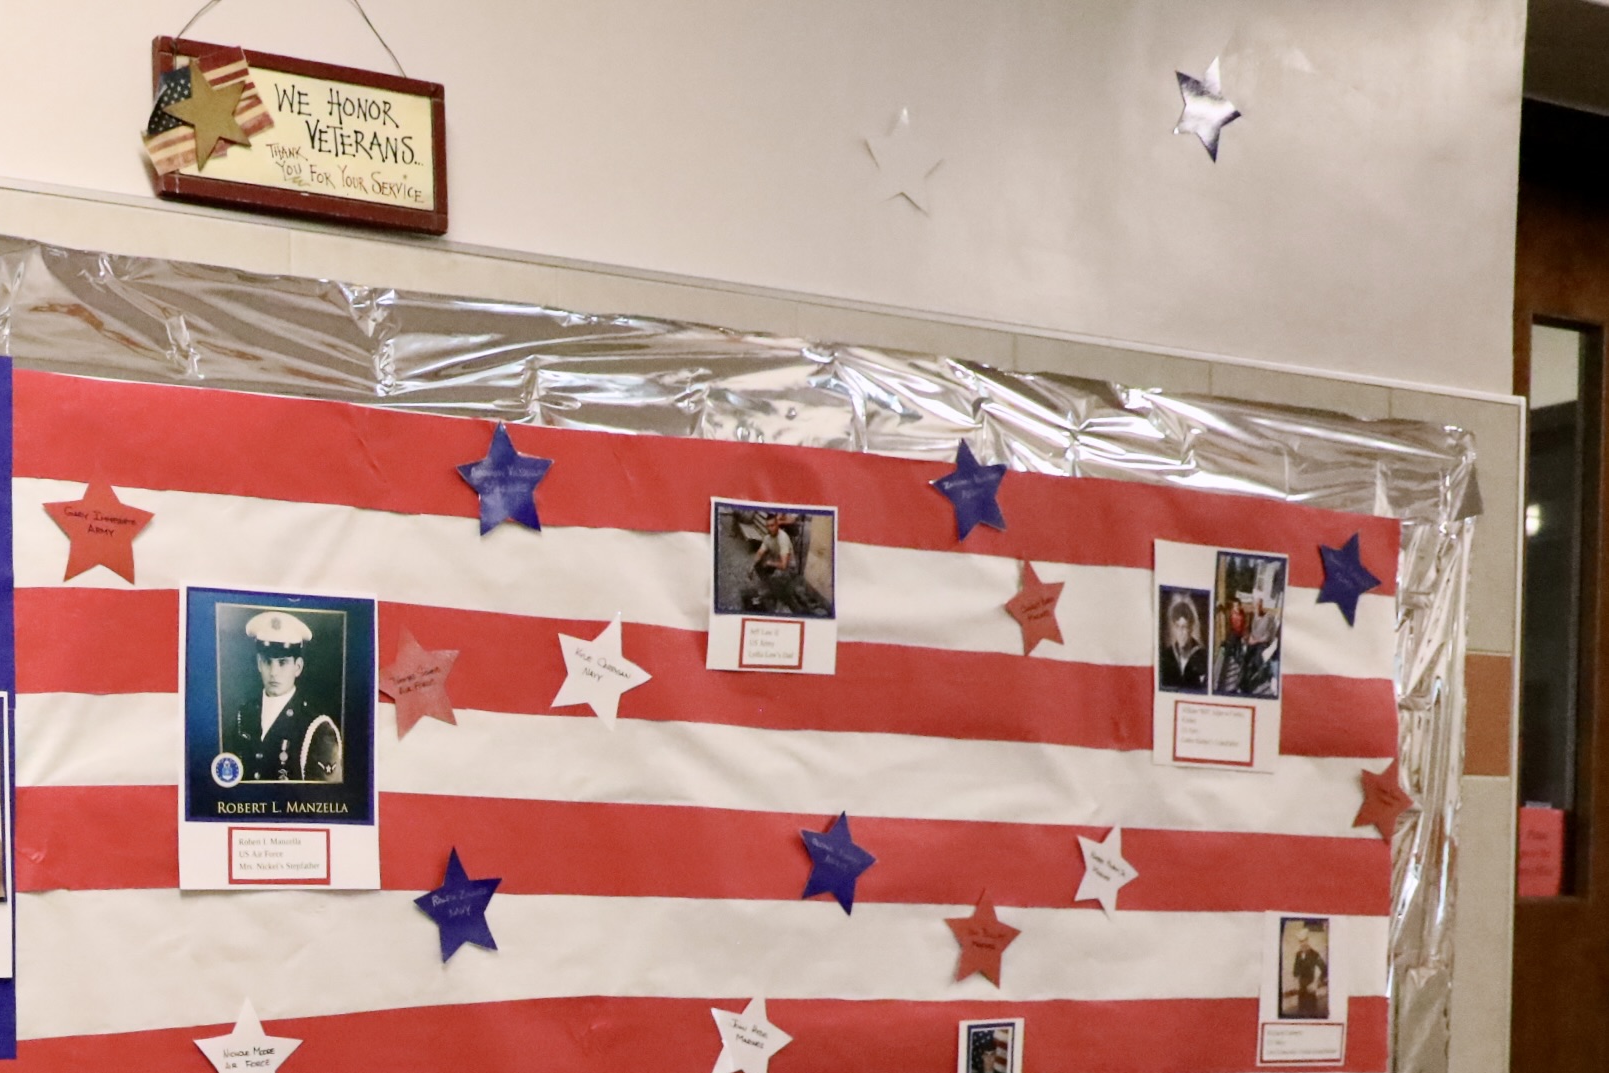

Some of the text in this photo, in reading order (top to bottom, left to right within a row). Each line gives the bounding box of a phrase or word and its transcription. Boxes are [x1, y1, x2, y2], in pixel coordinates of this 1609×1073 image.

[274, 83, 399, 128] WE HONOR
[305, 119, 424, 167] VETERANS...
[266, 143, 308, 161] THANK
[276, 161, 424, 204] YOU FOR YOUR SERVICE
[87, 523, 114, 537] ARMY
[217, 801, 348, 814] ROBERT L. MANZELLA
[253, 1046, 275, 1056] MOORE
[245, 1059, 271, 1068] FORCE
